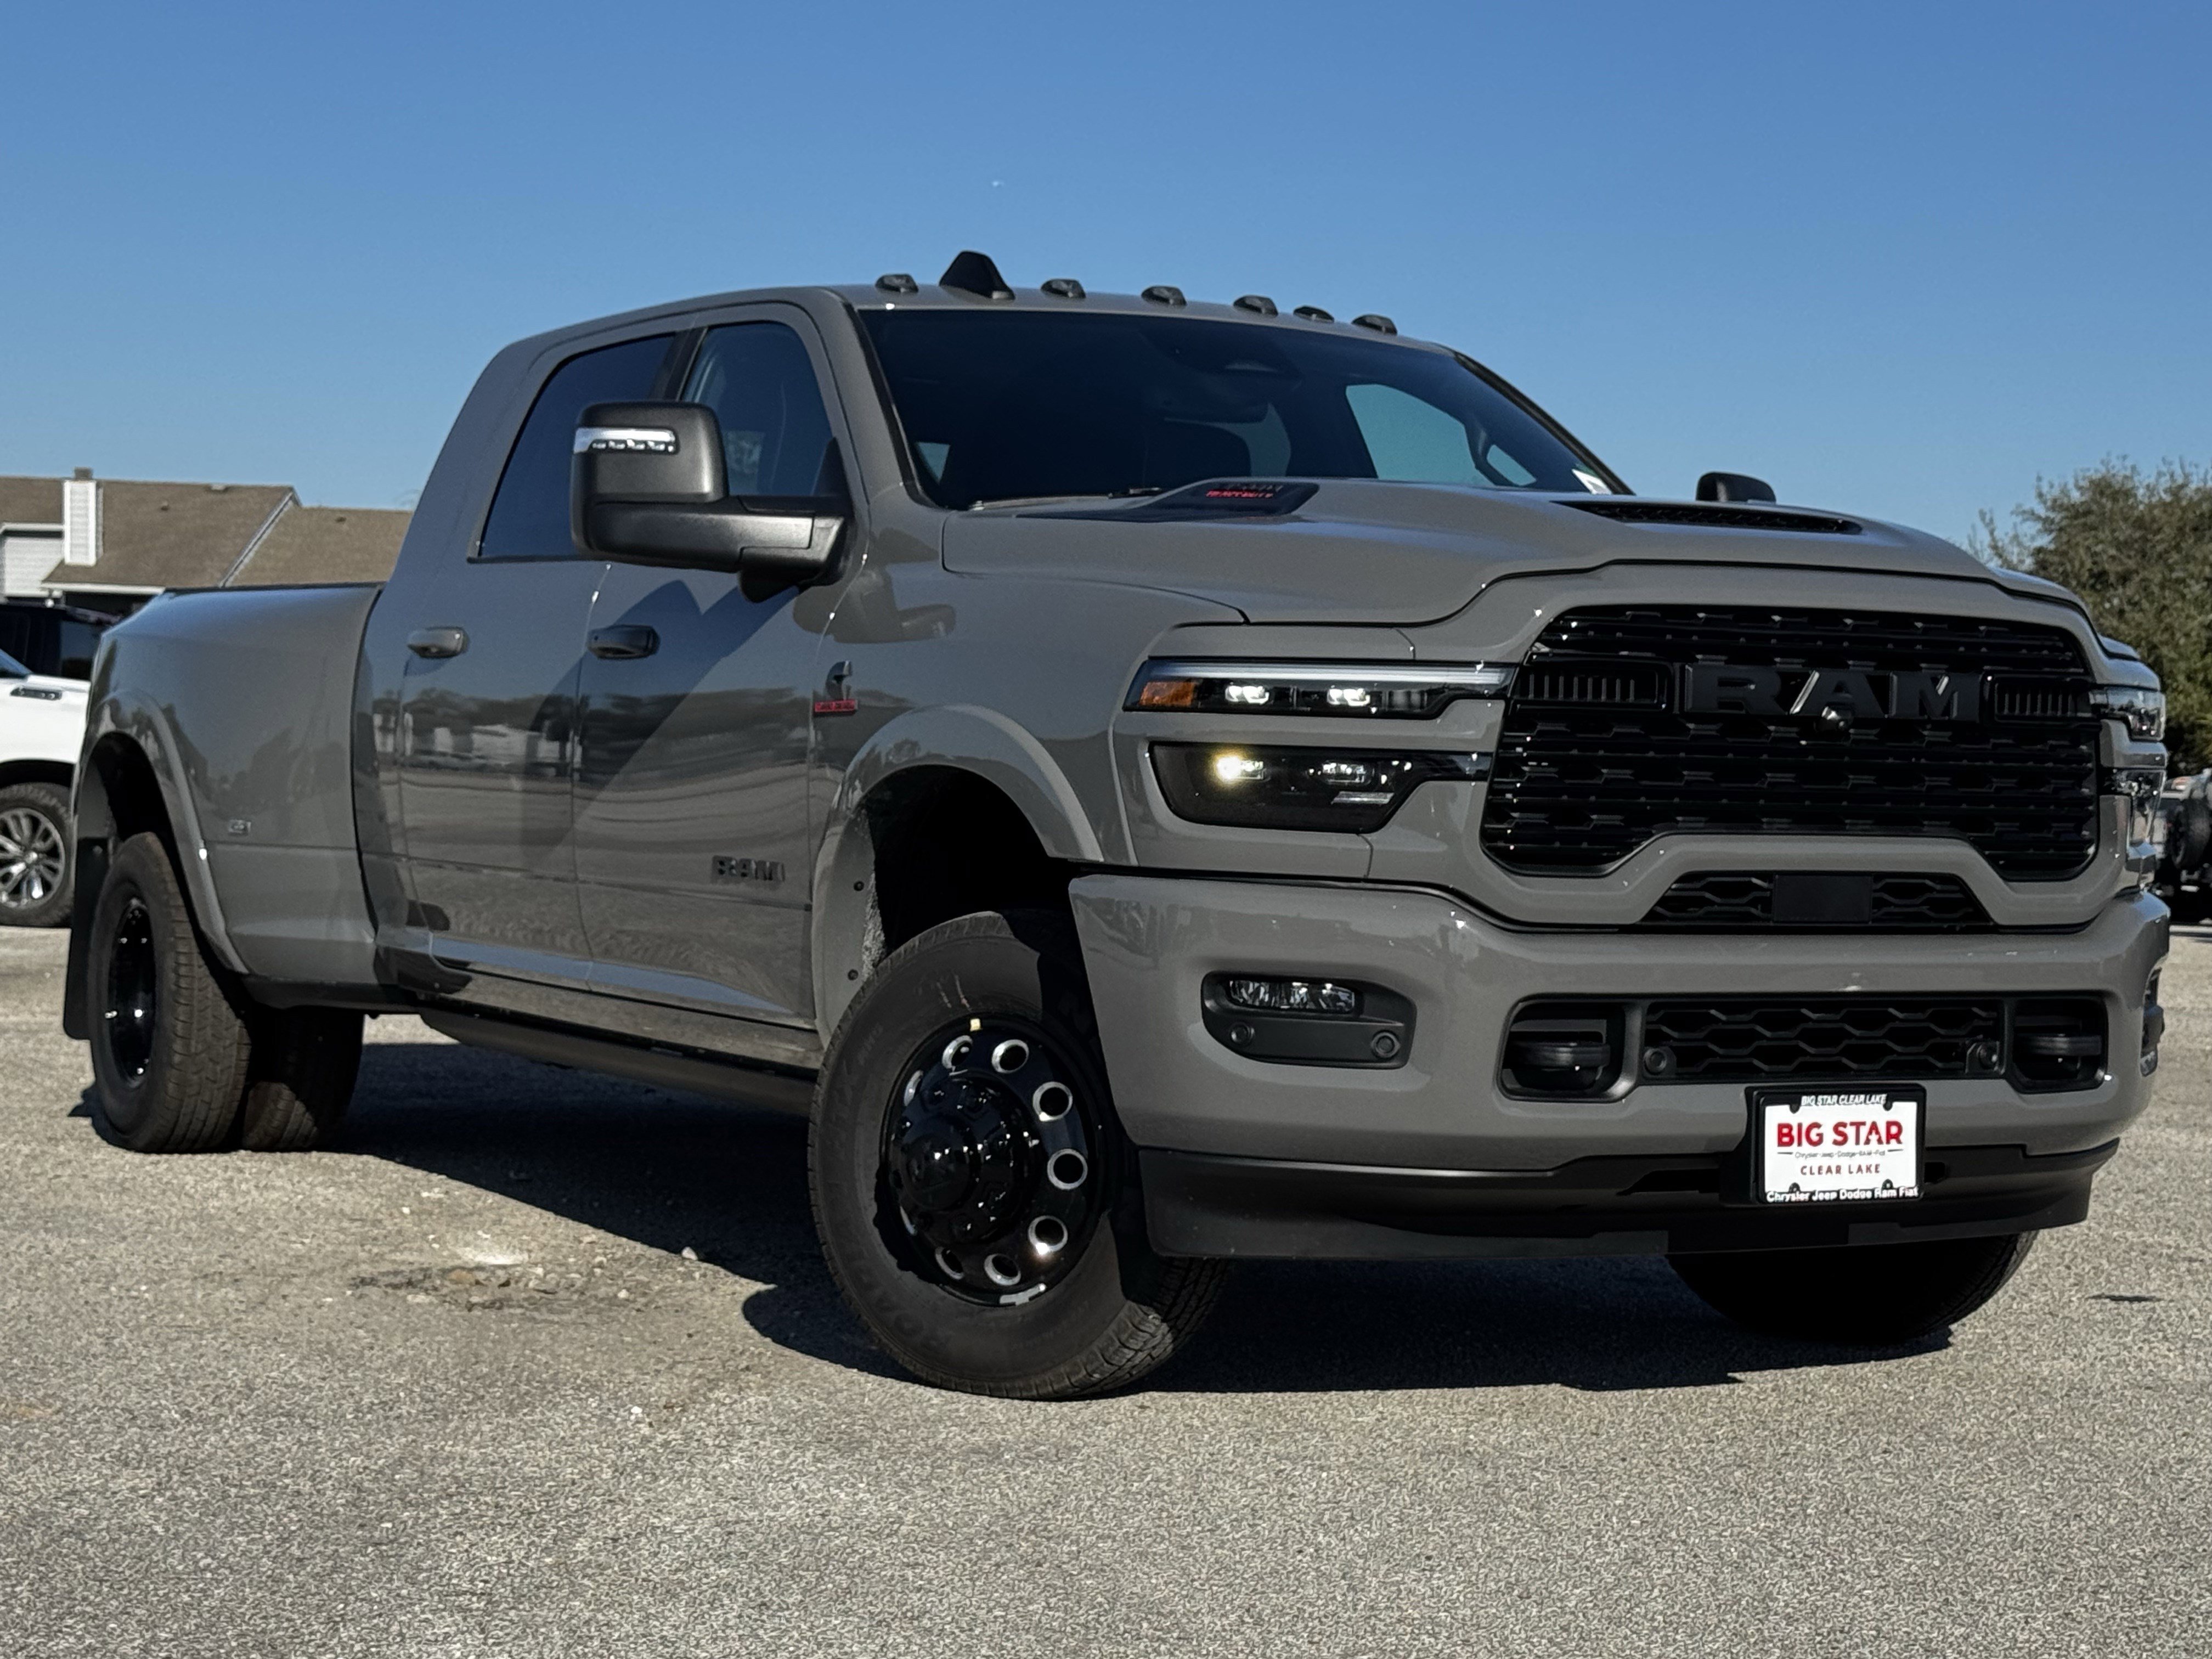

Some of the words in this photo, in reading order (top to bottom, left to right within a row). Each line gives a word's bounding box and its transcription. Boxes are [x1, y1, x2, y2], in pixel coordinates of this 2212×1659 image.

[1685, 663, 1980, 721] RAM
[712, 855, 785, 882] RAM
[1817, 1095, 1837, 1105] STAR
[1839, 1094, 1865, 1104] CLEAR
[1866, 1094, 1887, 1104] LAKE
[1777, 1122, 1824, 1148] BIG
[1832, 1120, 1903, 1146] STAR
[1801, 1164, 1842, 1176] CLEAR
[1848, 1163, 1881, 1174] LAKE
[1767, 1190, 1810, 1203] Chrysler
[1812, 1189, 1837, 1201] Jeep
[1839, 1188, 1872, 1200] Dodge
[1874, 1187, 1897, 1198] Ram
[1899, 1186, 1919, 1197] Fiat
